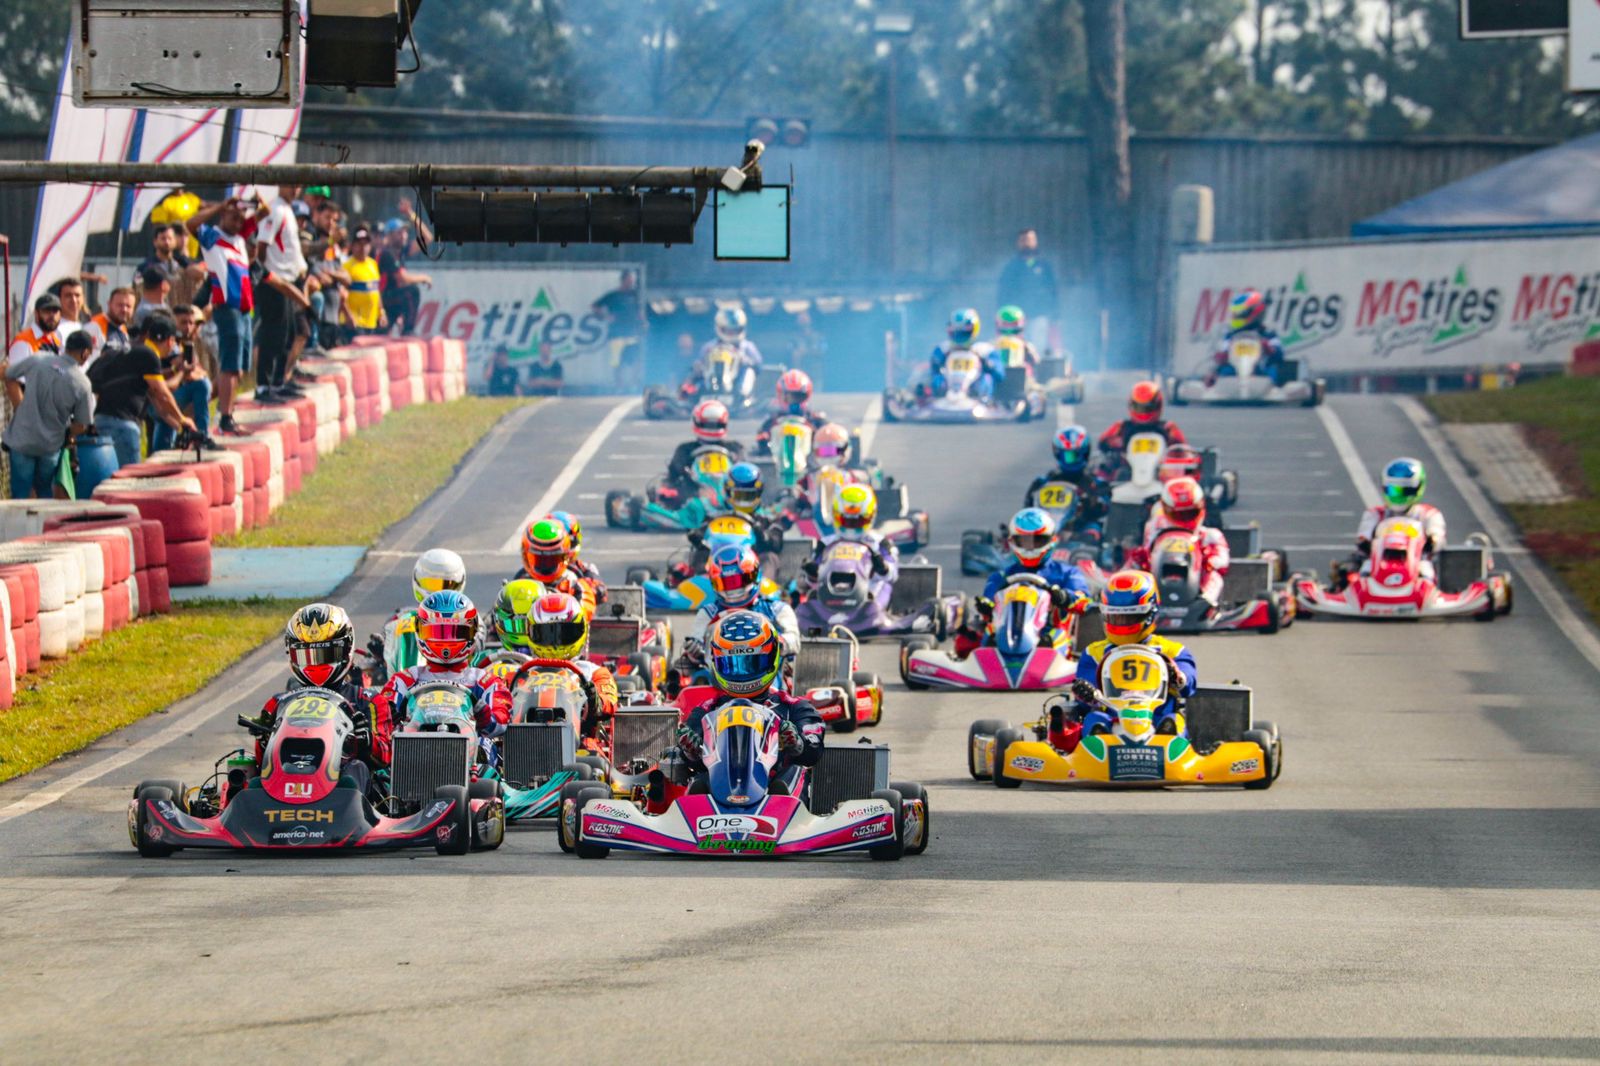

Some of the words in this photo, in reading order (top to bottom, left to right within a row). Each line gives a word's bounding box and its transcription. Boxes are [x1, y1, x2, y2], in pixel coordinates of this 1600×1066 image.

[1355, 278, 1500, 327] MGtires
[1511, 273, 1600, 321] MGti
[1191, 286, 1343, 334] Mtires
[1122, 659, 1151, 681] 57
[290, 699, 332, 716] 293
[724, 708, 755, 724] 10
[263, 809, 335, 824] TECH
[594, 803, 632, 819] MGtires
[847, 804, 884, 819] MGtires
[698, 817, 743, 830] One
